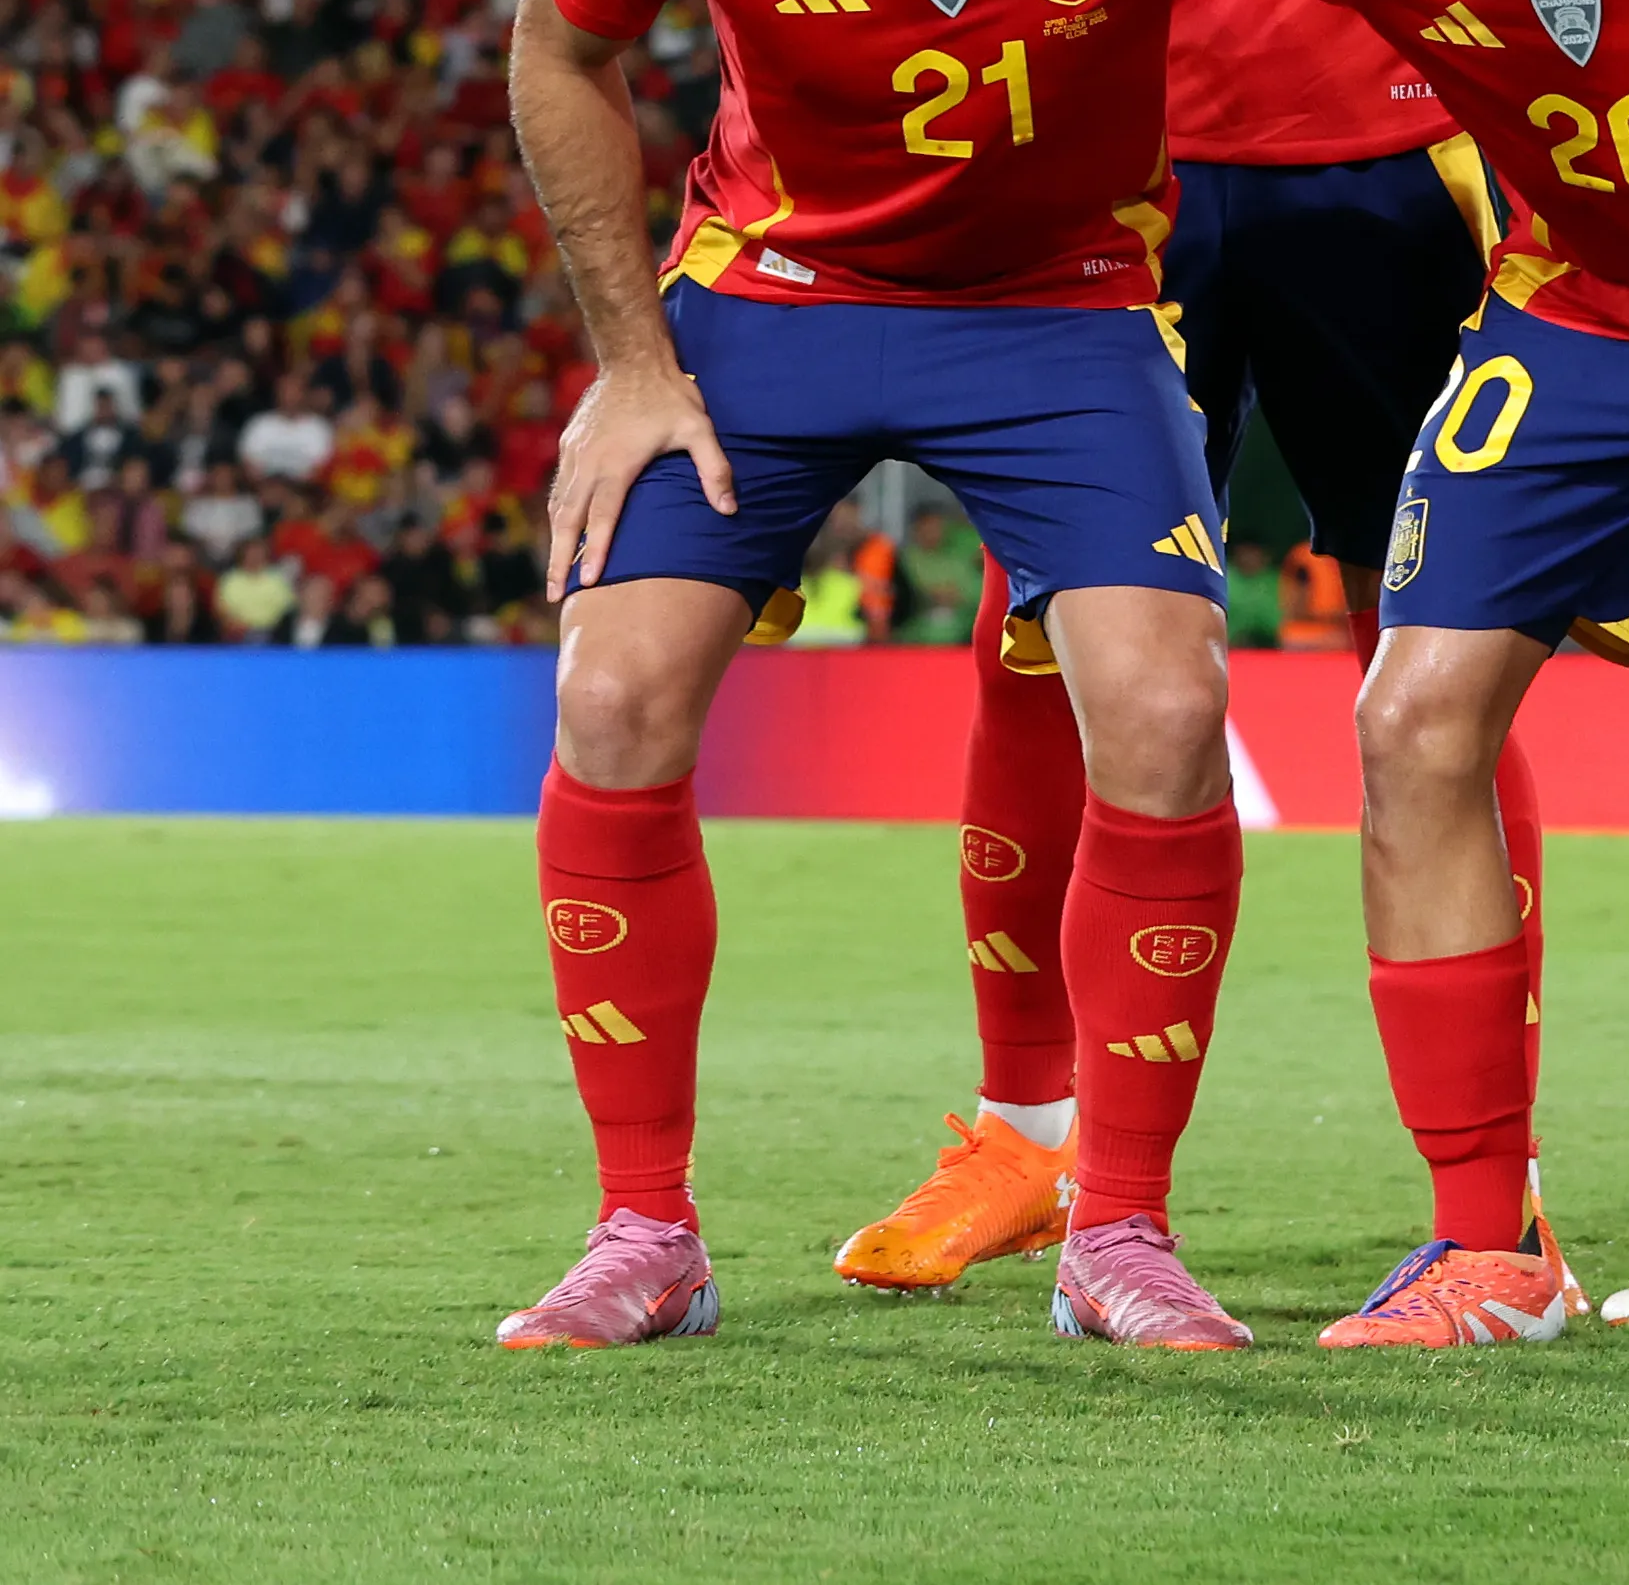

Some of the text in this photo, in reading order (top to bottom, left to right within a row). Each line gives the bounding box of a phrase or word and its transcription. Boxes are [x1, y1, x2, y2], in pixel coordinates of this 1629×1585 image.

[1561, 34, 1591, 45] 2024
[891, 39, 1035, 159] 21
[1405, 354, 1534, 473] 0
[557, 909, 602, 927] RF
[559, 925, 602, 942] EF
[1153, 935, 1200, 949] RF
[1151, 950, 1199, 965] EF
